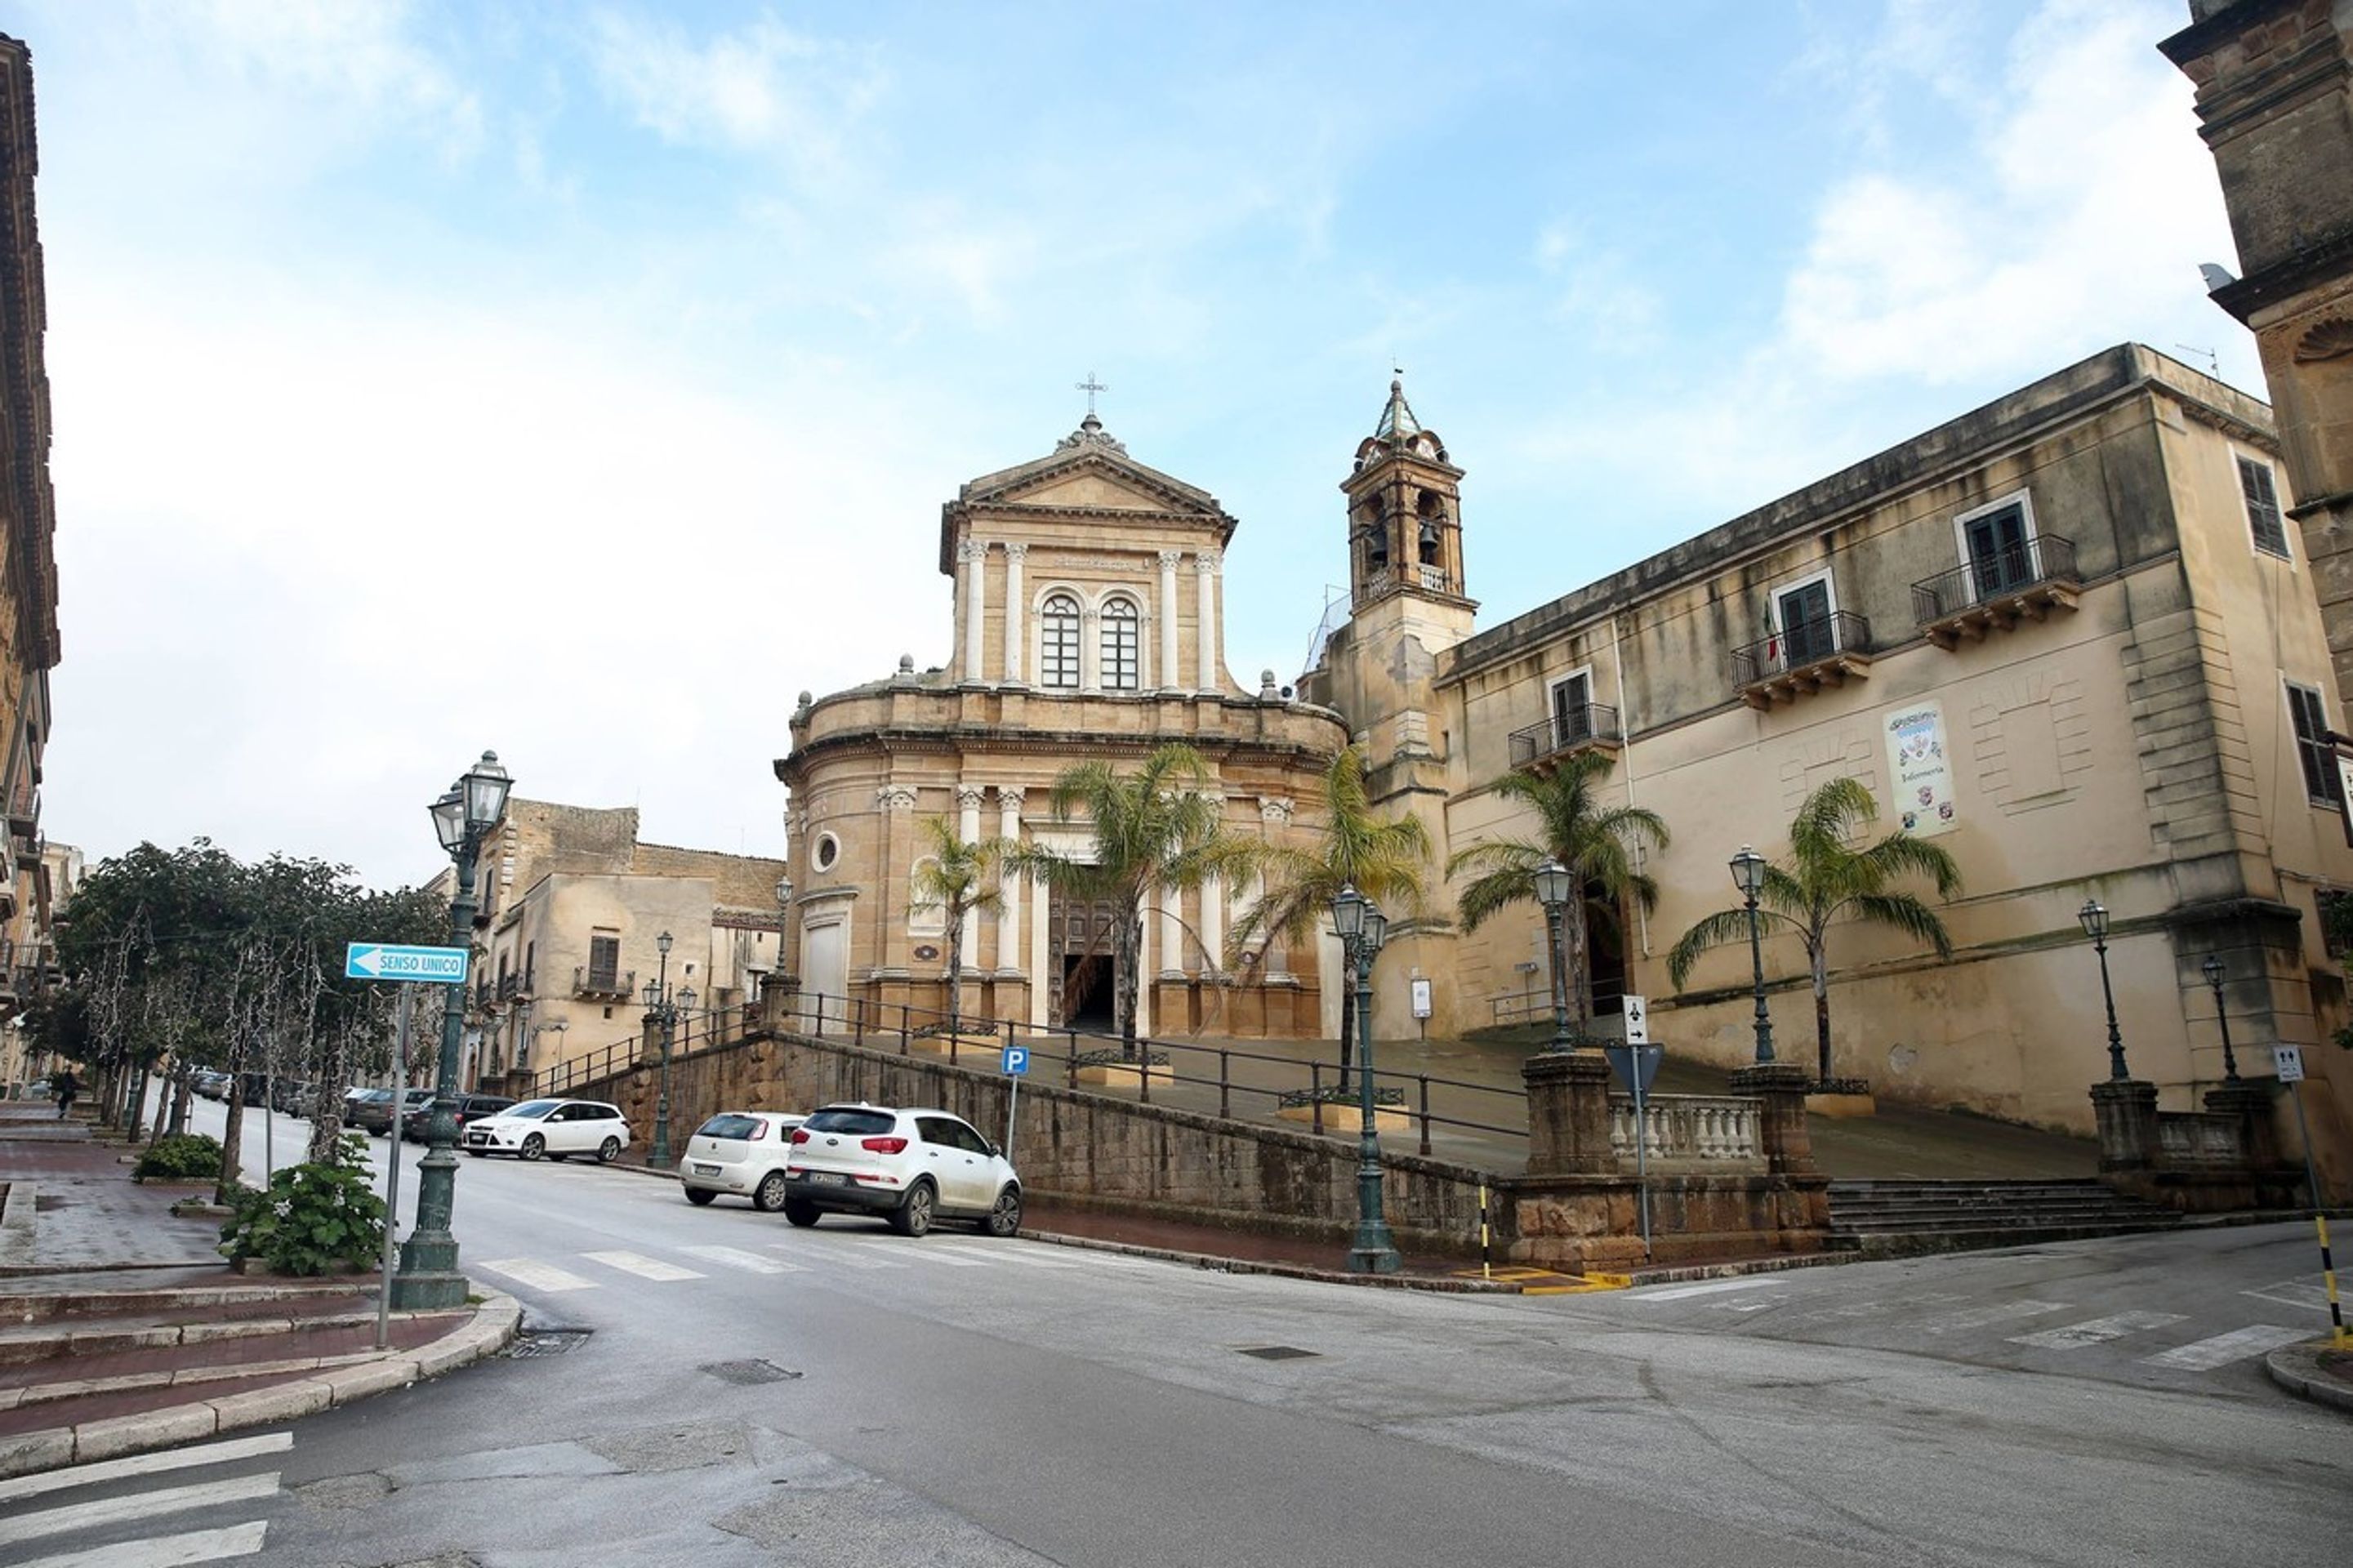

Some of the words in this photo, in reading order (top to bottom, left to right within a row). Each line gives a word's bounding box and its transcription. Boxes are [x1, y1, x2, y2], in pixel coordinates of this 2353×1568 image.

[380, 956, 419, 971] SENSO
[421, 957, 459, 972] UNICO
[1008, 1050, 1024, 1071] P
